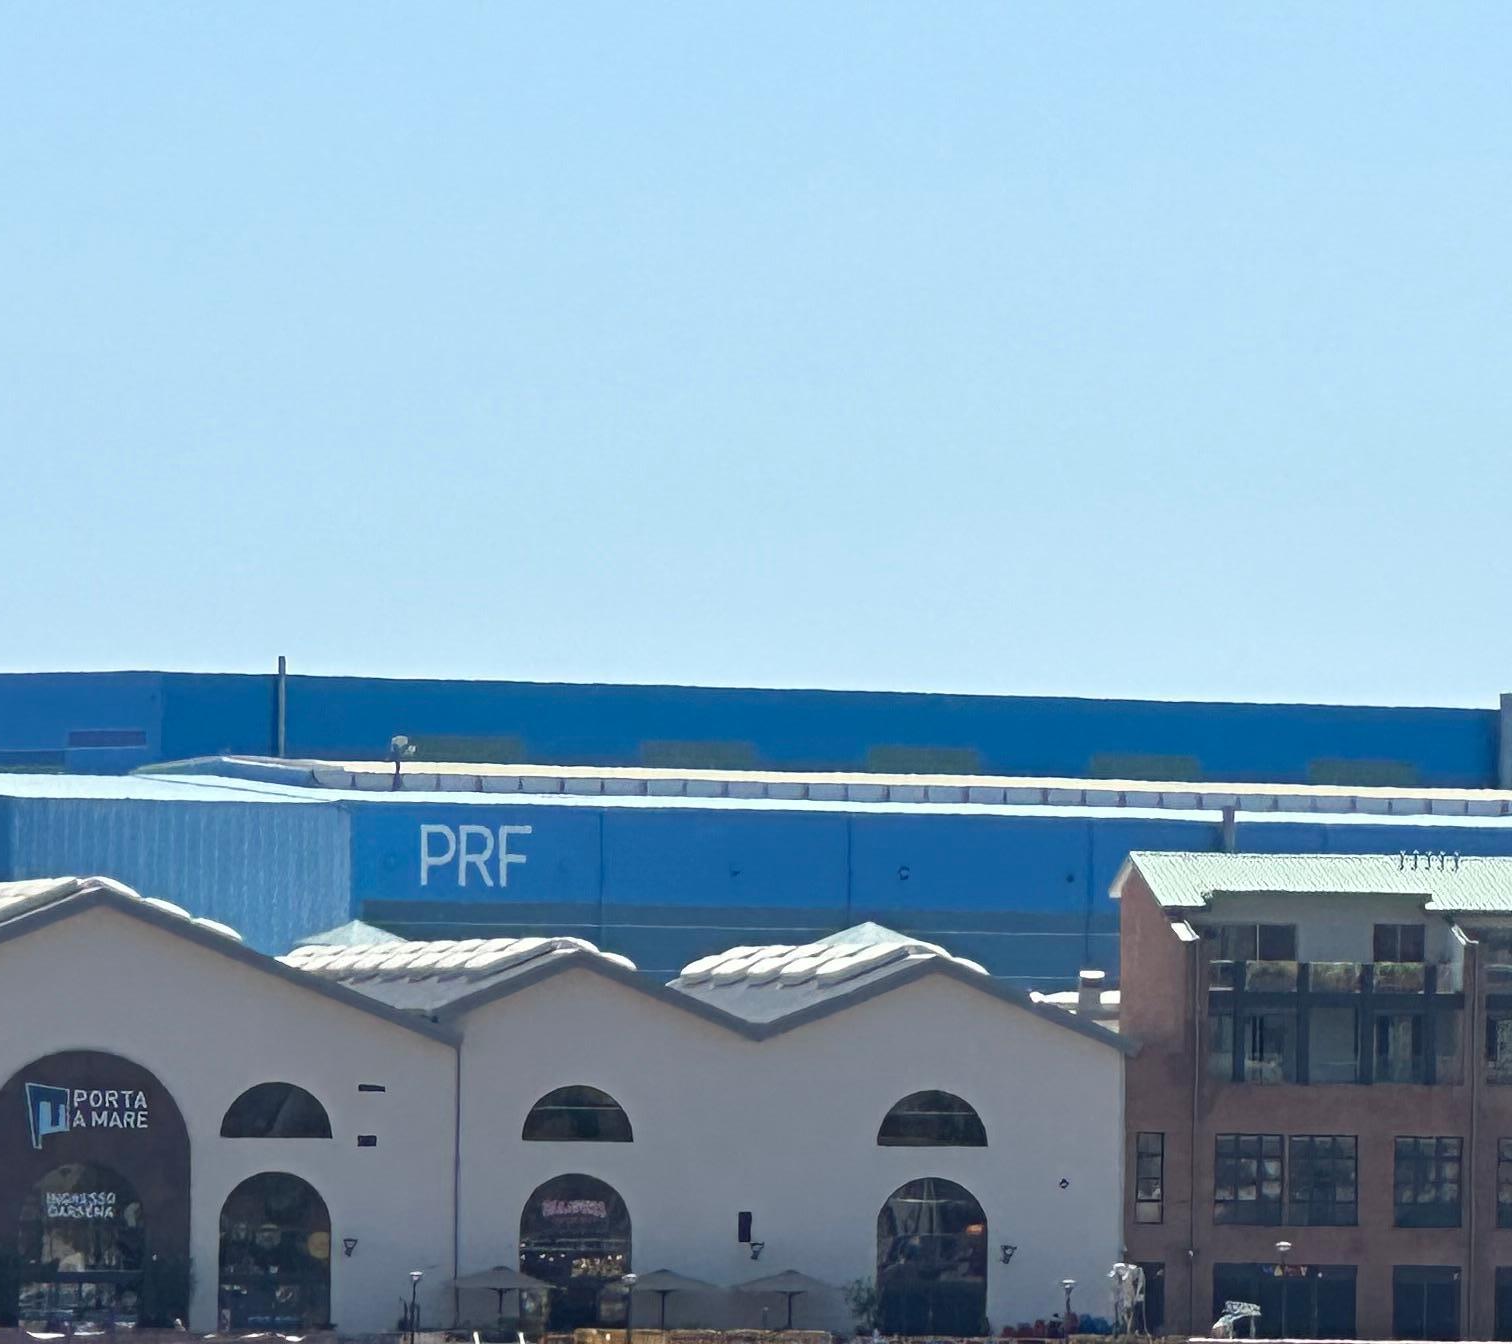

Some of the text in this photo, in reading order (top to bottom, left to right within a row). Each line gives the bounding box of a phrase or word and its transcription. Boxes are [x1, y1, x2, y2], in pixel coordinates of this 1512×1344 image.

[420, 824, 533, 888] PRF
[73, 1089, 148, 1109] PORTA
[72, 1109, 149, 1129] A MARE
